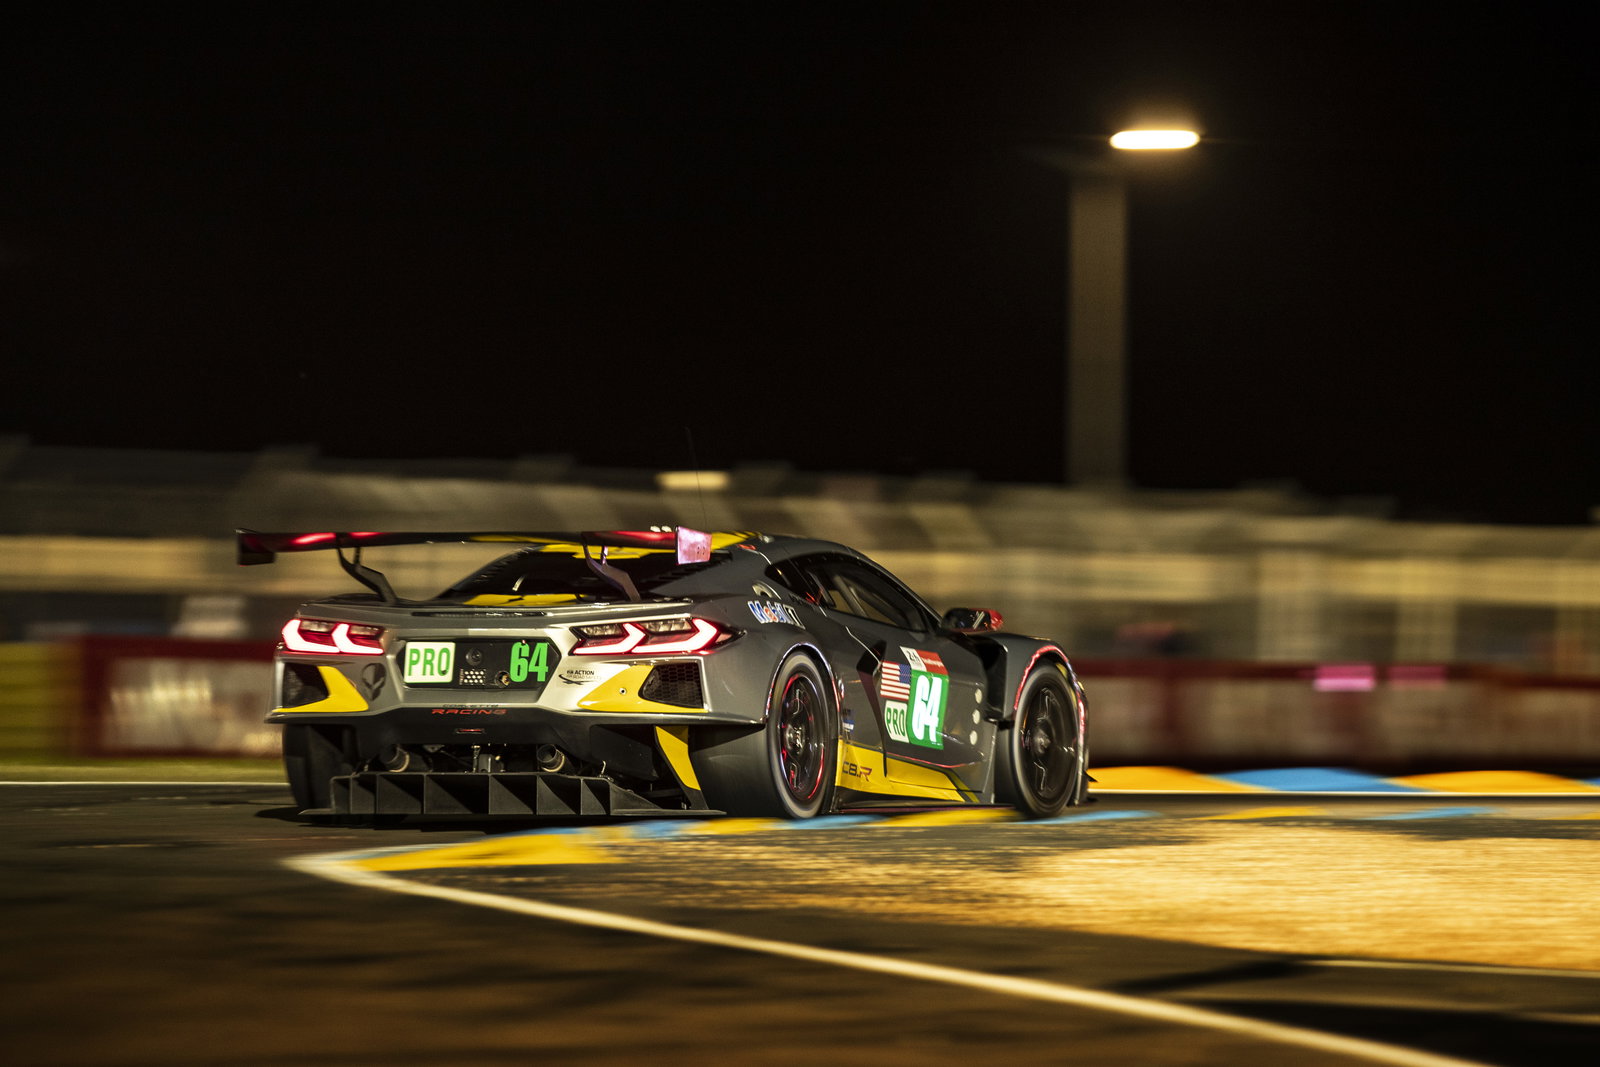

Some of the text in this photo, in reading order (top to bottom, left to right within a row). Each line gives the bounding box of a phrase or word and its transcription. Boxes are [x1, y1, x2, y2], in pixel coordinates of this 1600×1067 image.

[408, 647, 450, 677] PRO
[509, 641, 549, 682] 64
[886, 707, 905, 737] PRO
[912, 675, 942, 742] 64
